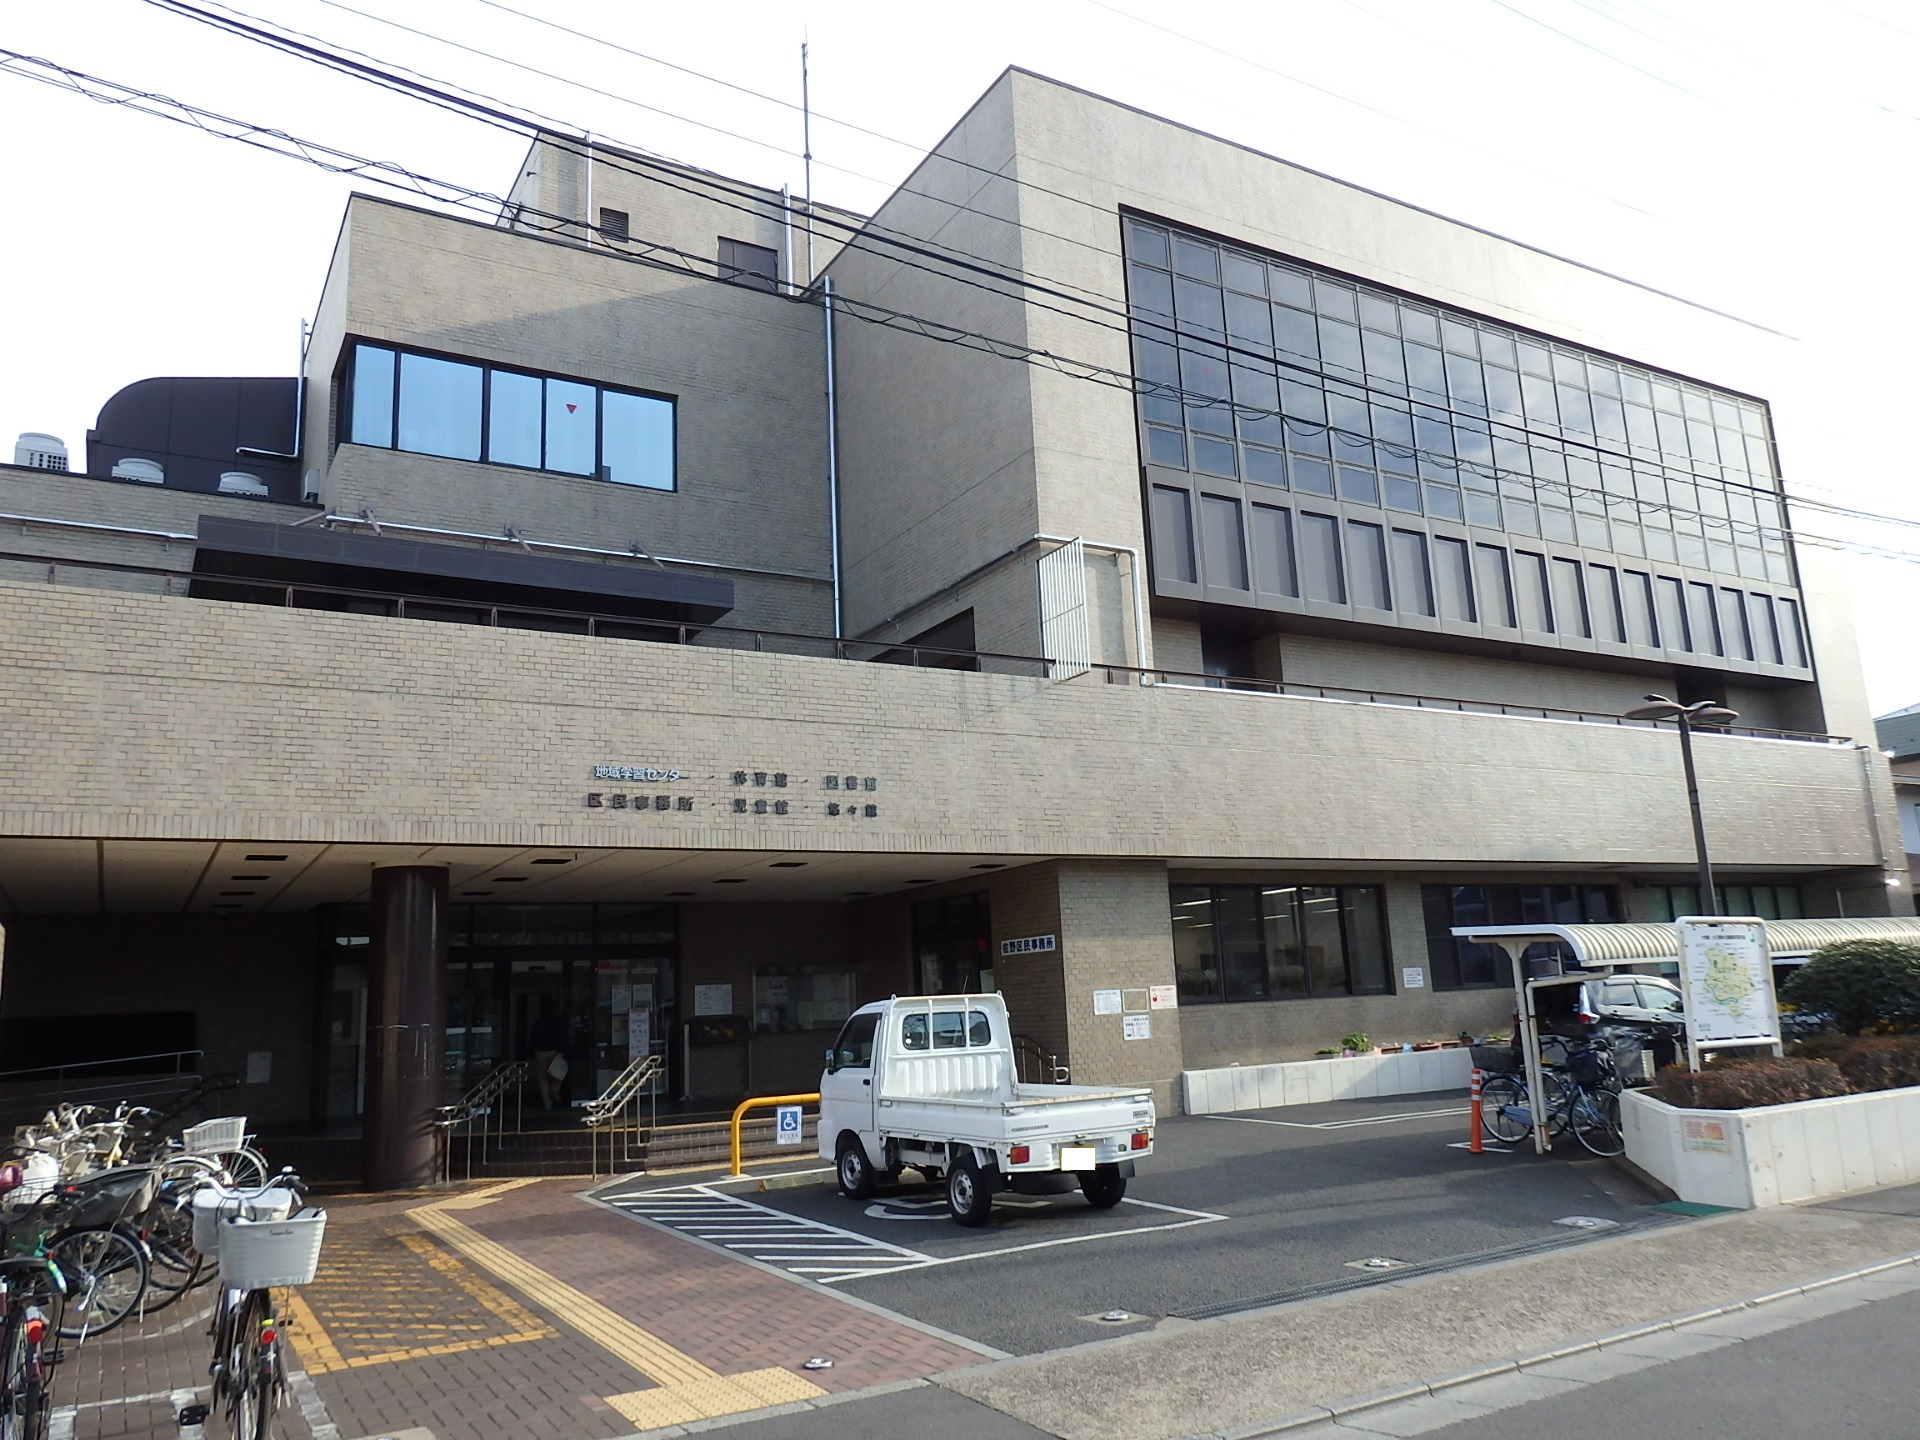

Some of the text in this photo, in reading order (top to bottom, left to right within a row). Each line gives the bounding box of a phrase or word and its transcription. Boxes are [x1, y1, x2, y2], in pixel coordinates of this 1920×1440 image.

[1002, 936, 1054, 954] 佐野区民事務所
